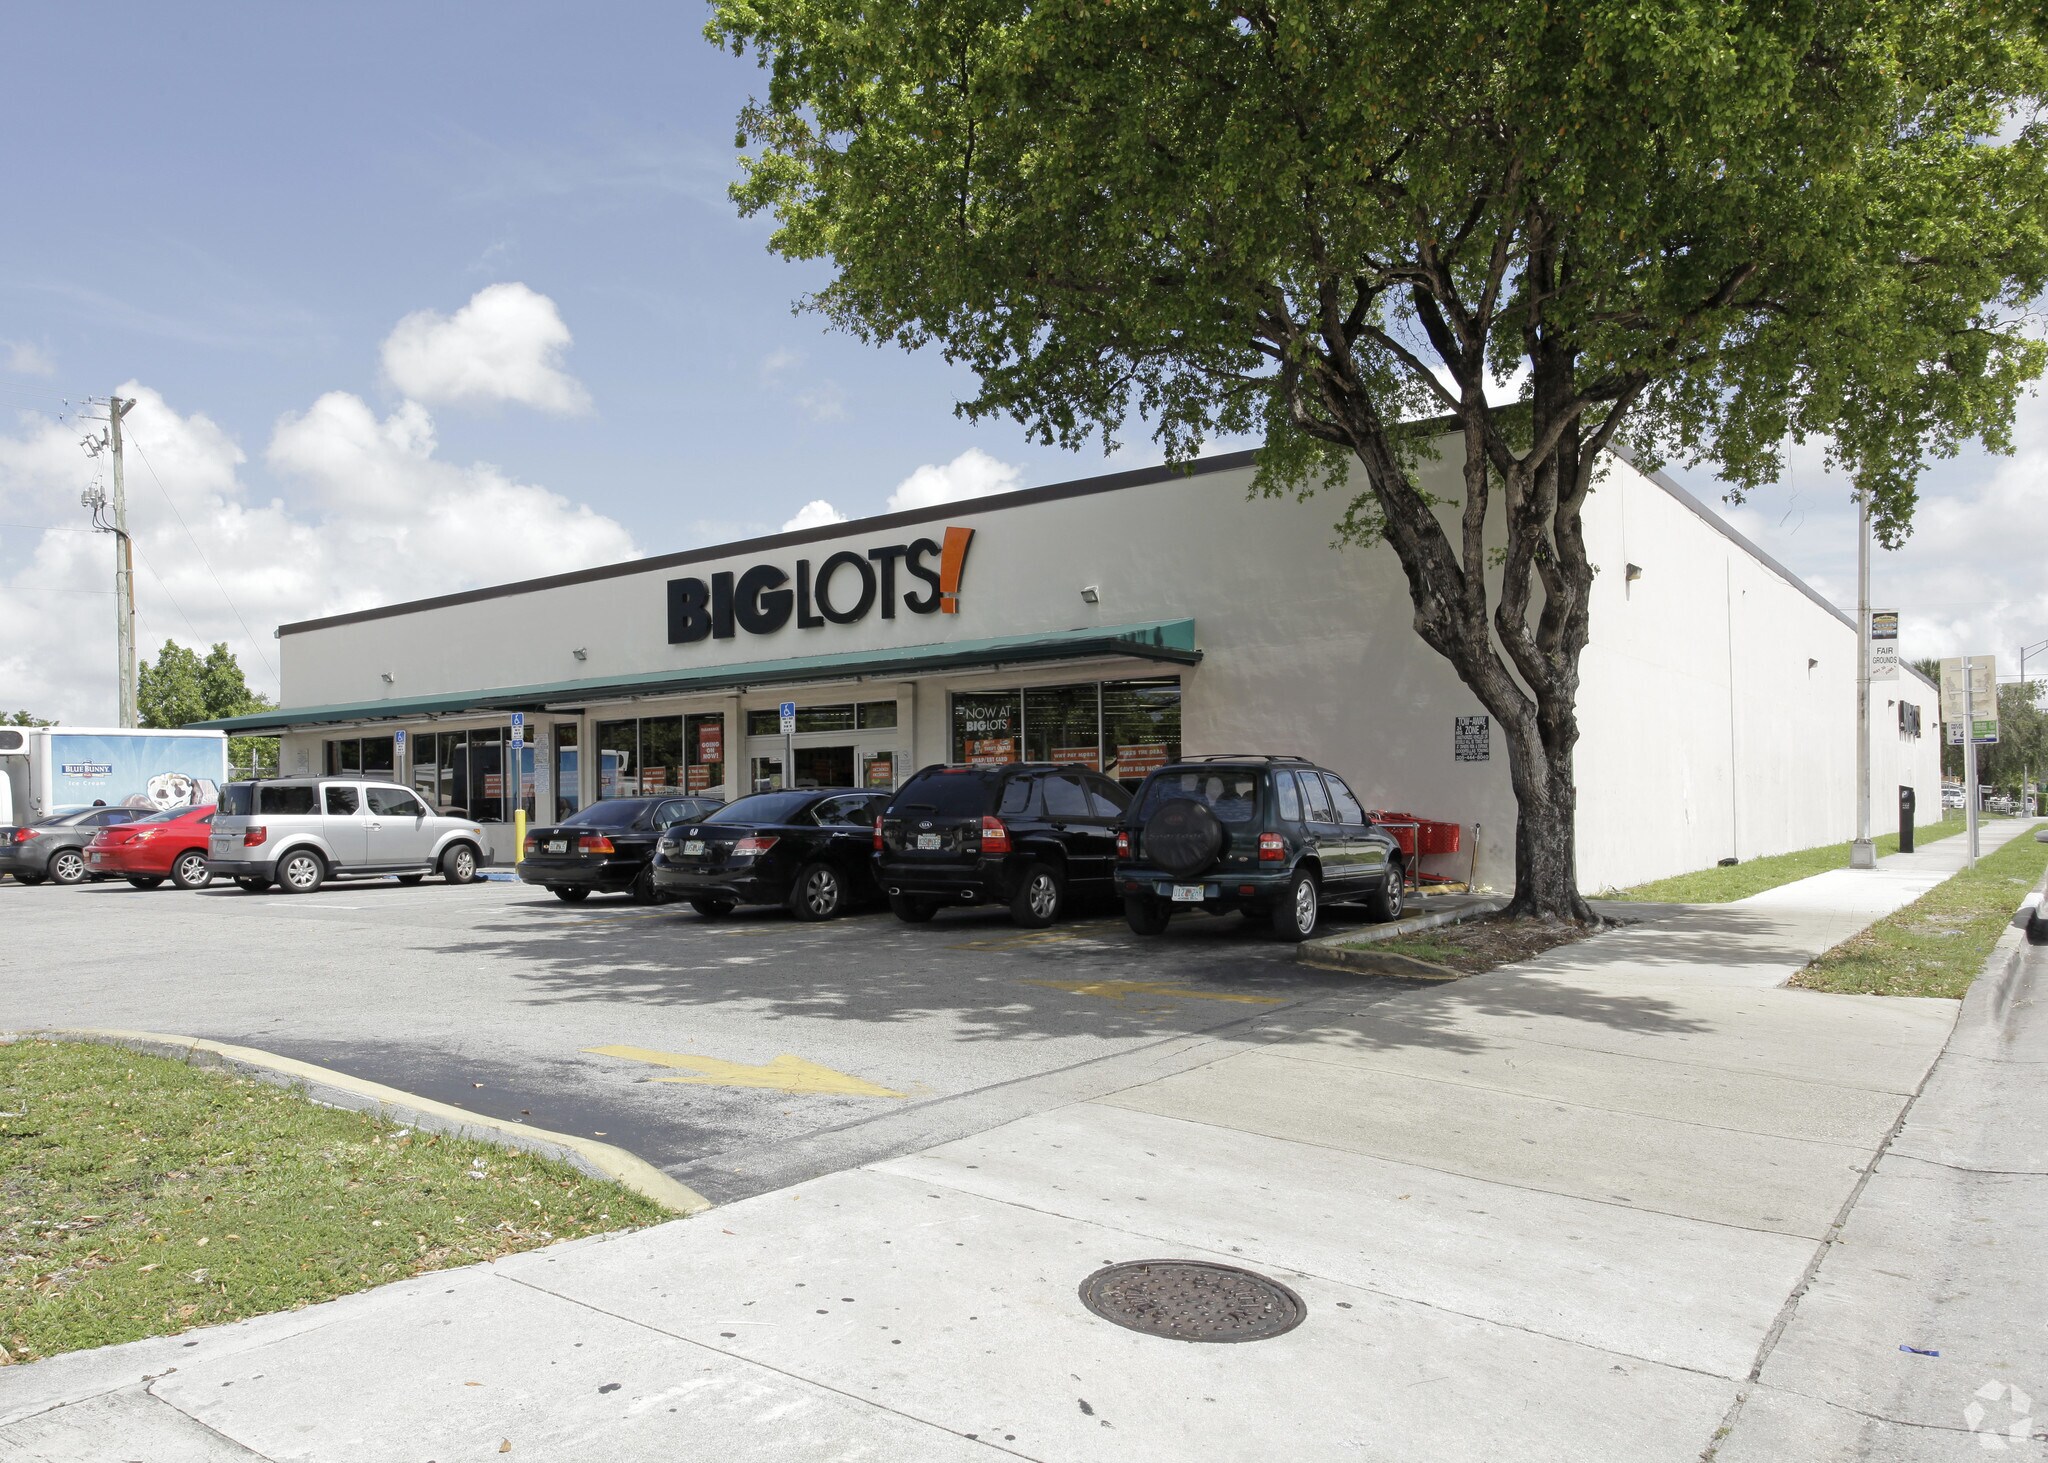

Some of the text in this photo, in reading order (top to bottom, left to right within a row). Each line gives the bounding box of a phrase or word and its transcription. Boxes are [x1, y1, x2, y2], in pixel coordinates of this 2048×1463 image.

[1872, 656, 1898, 664] GROUNDS
[966, 705, 1011, 719] NOW AT
[65, 765, 84, 773] BLUE
